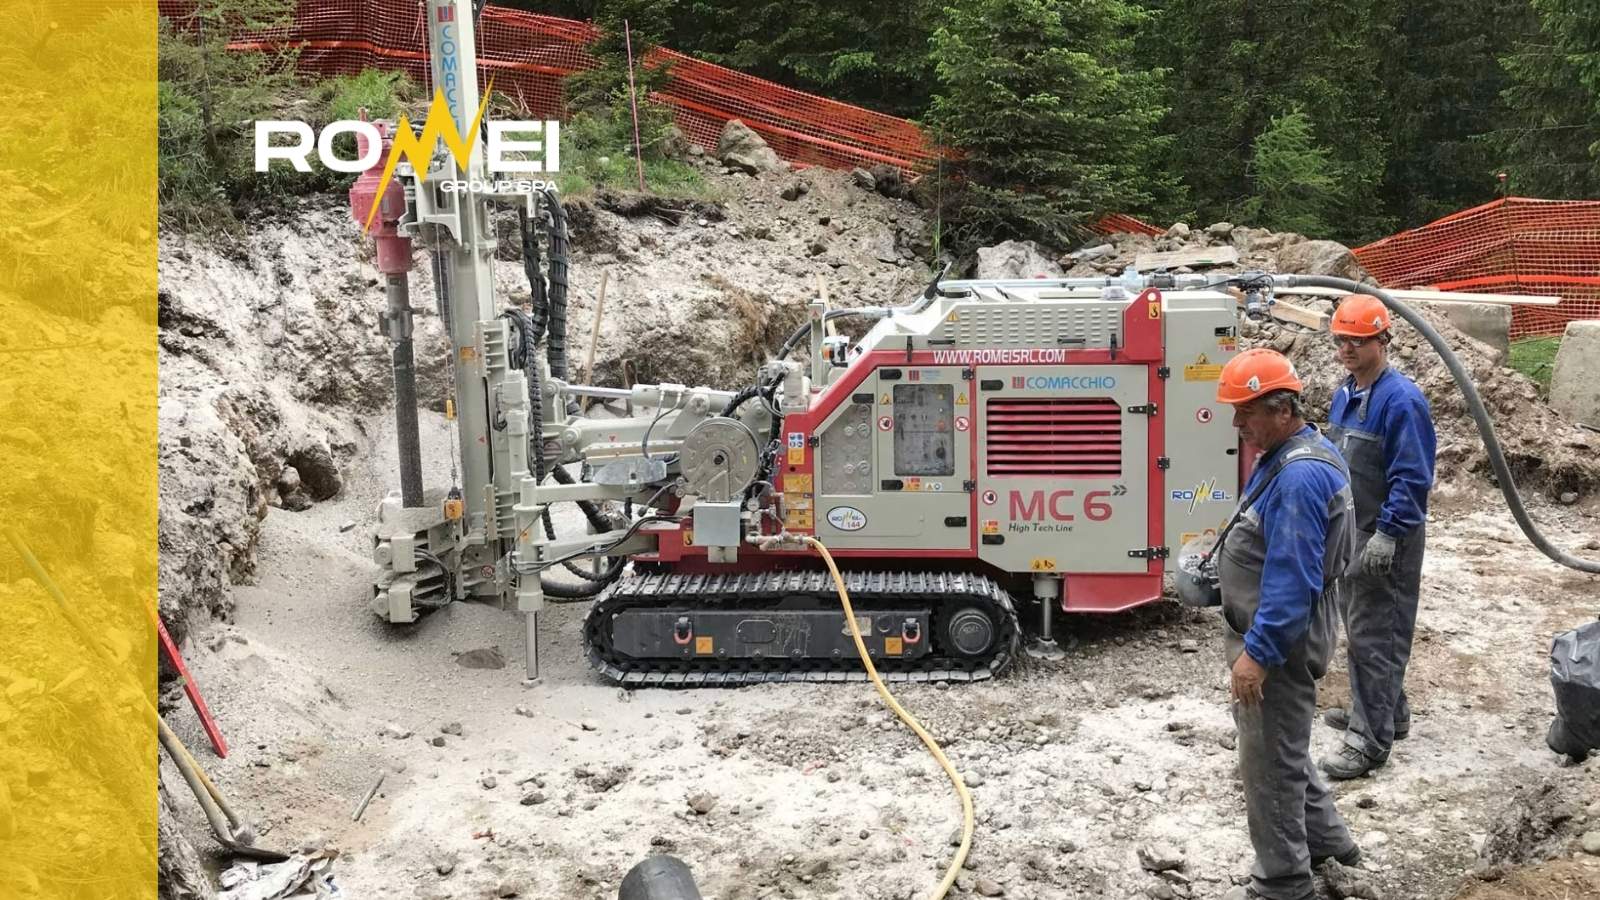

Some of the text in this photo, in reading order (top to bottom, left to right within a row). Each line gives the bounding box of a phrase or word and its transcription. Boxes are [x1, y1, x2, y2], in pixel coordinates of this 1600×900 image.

[932, 349, 1065, 364] WWW.ROMEISRL.COM
[1026, 376, 1116, 389] COMACCHIO
[1009, 490, 1113, 521] MC 6
[1008, 523, 1030, 533] High
[1032, 523, 1054, 532] Tech
